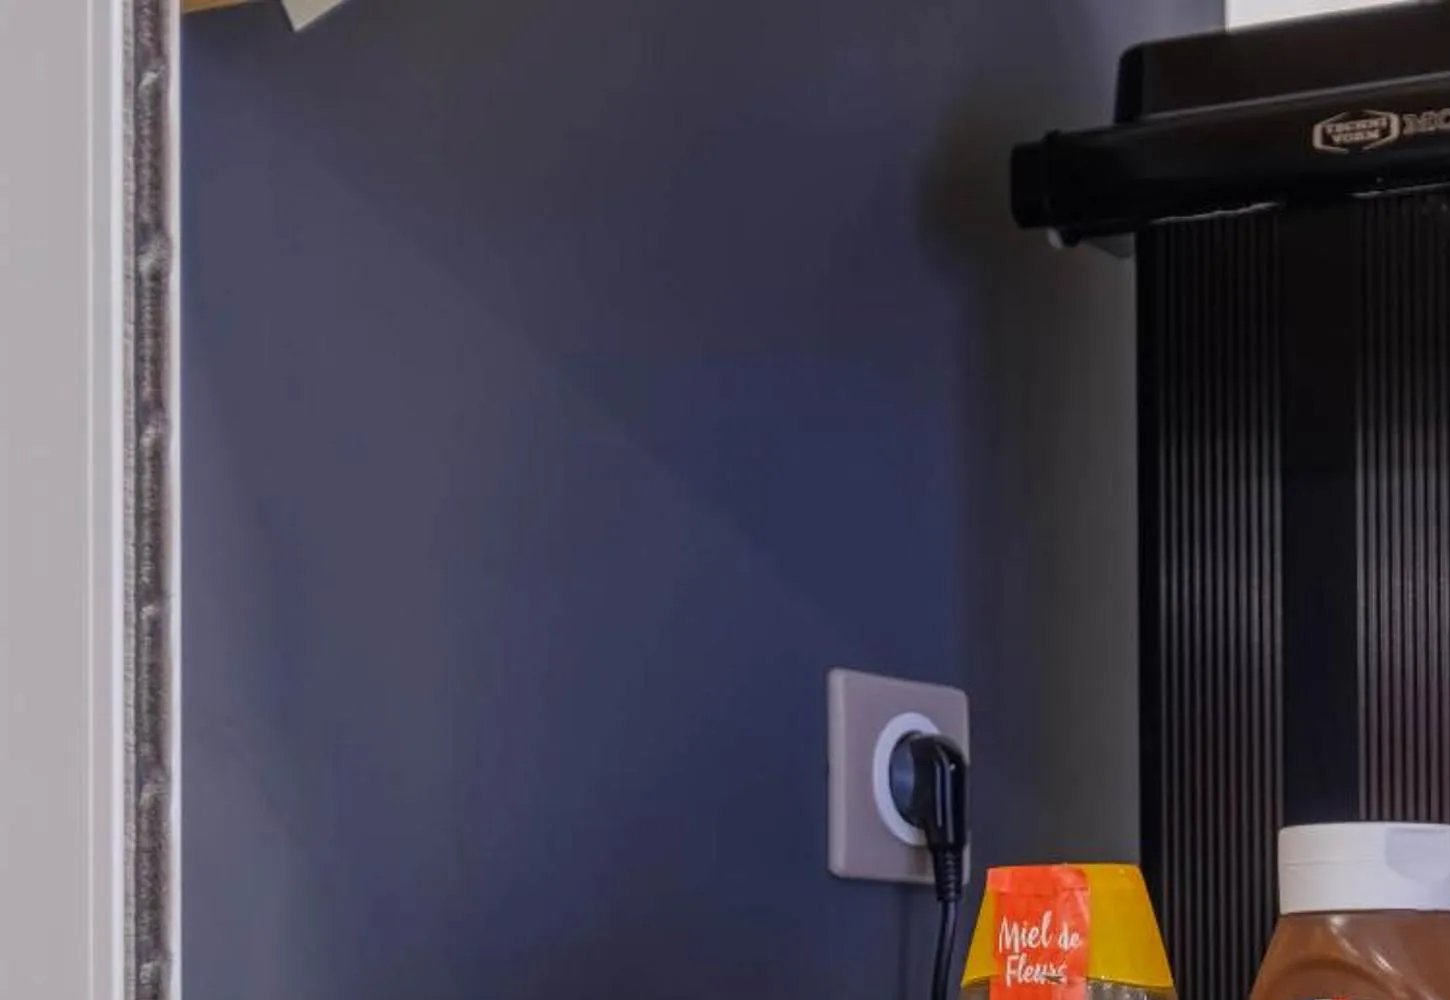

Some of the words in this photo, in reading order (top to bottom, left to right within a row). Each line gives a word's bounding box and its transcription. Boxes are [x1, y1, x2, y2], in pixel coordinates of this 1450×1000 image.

[999, 910, 1053, 956] Miel
[1058, 920, 1083, 951] de
[1005, 954, 1069, 987] Fleurs
